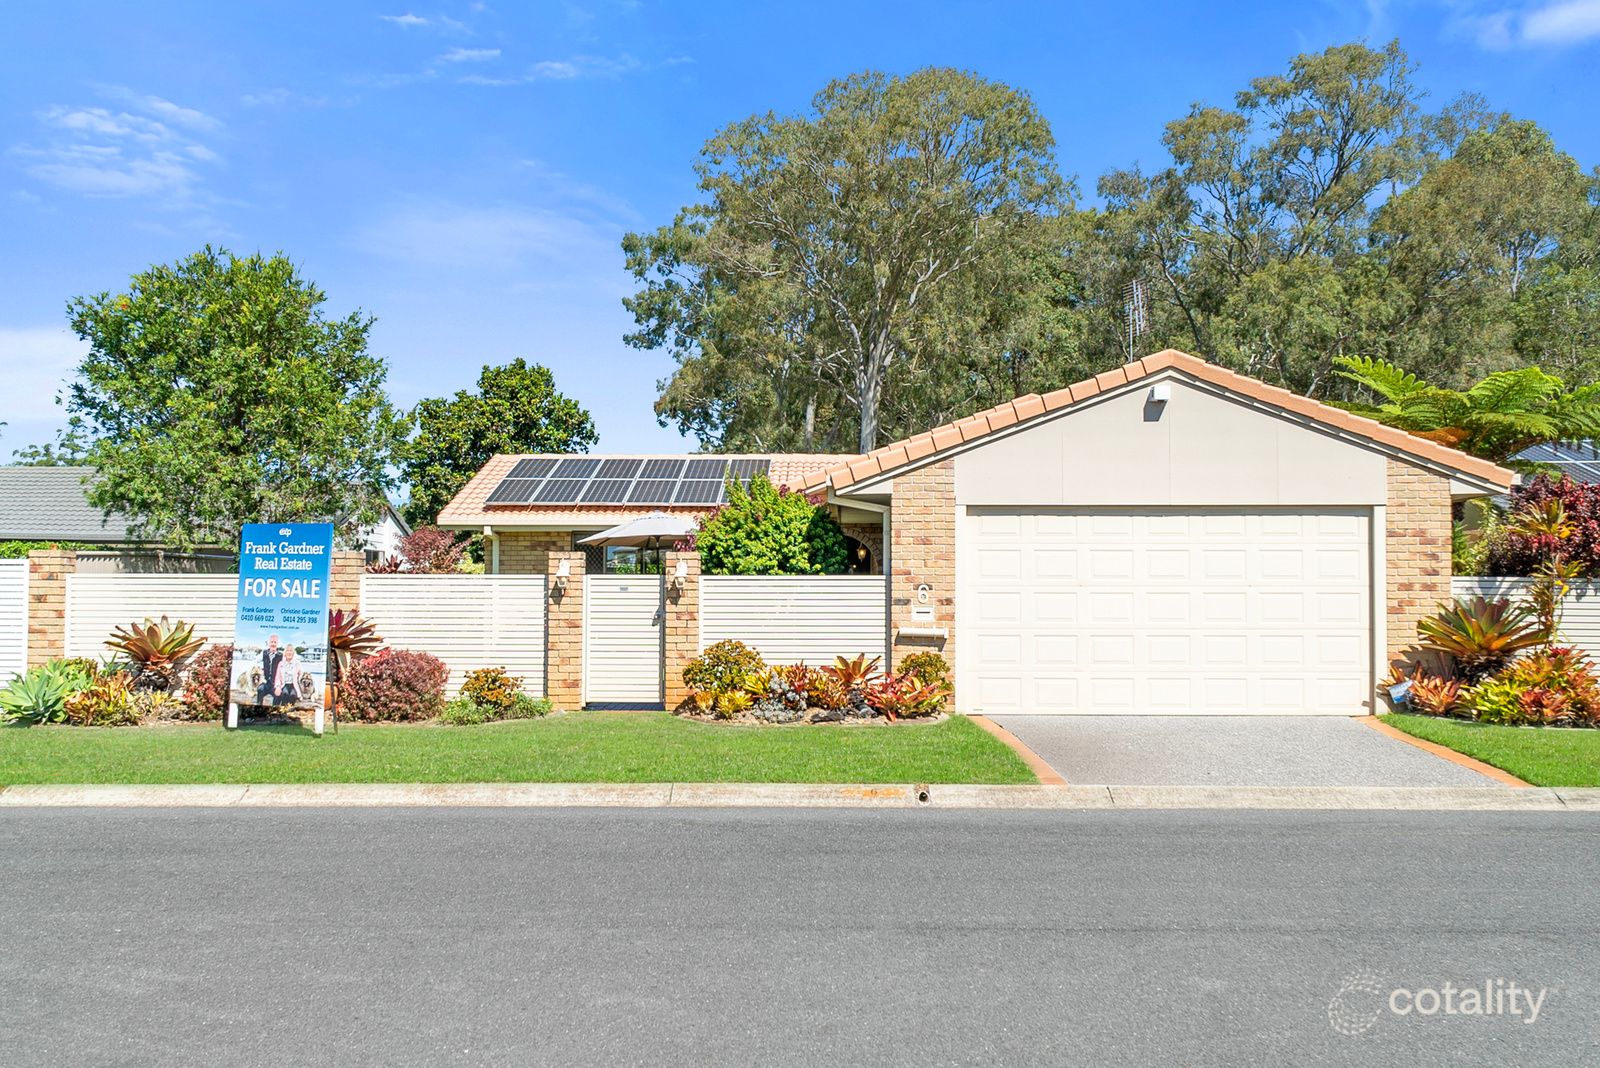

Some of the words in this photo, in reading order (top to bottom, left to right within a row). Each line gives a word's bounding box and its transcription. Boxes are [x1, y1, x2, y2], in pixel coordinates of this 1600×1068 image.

[244, 541, 277, 555] Frank
[279, 541, 325, 555] Gardner
[254, 557, 278, 570] Real
[280, 557, 313, 571] Estate
[244, 578, 277, 598] FOR
[280, 578, 321, 599] SALE
[917, 584, 930, 604] 6
